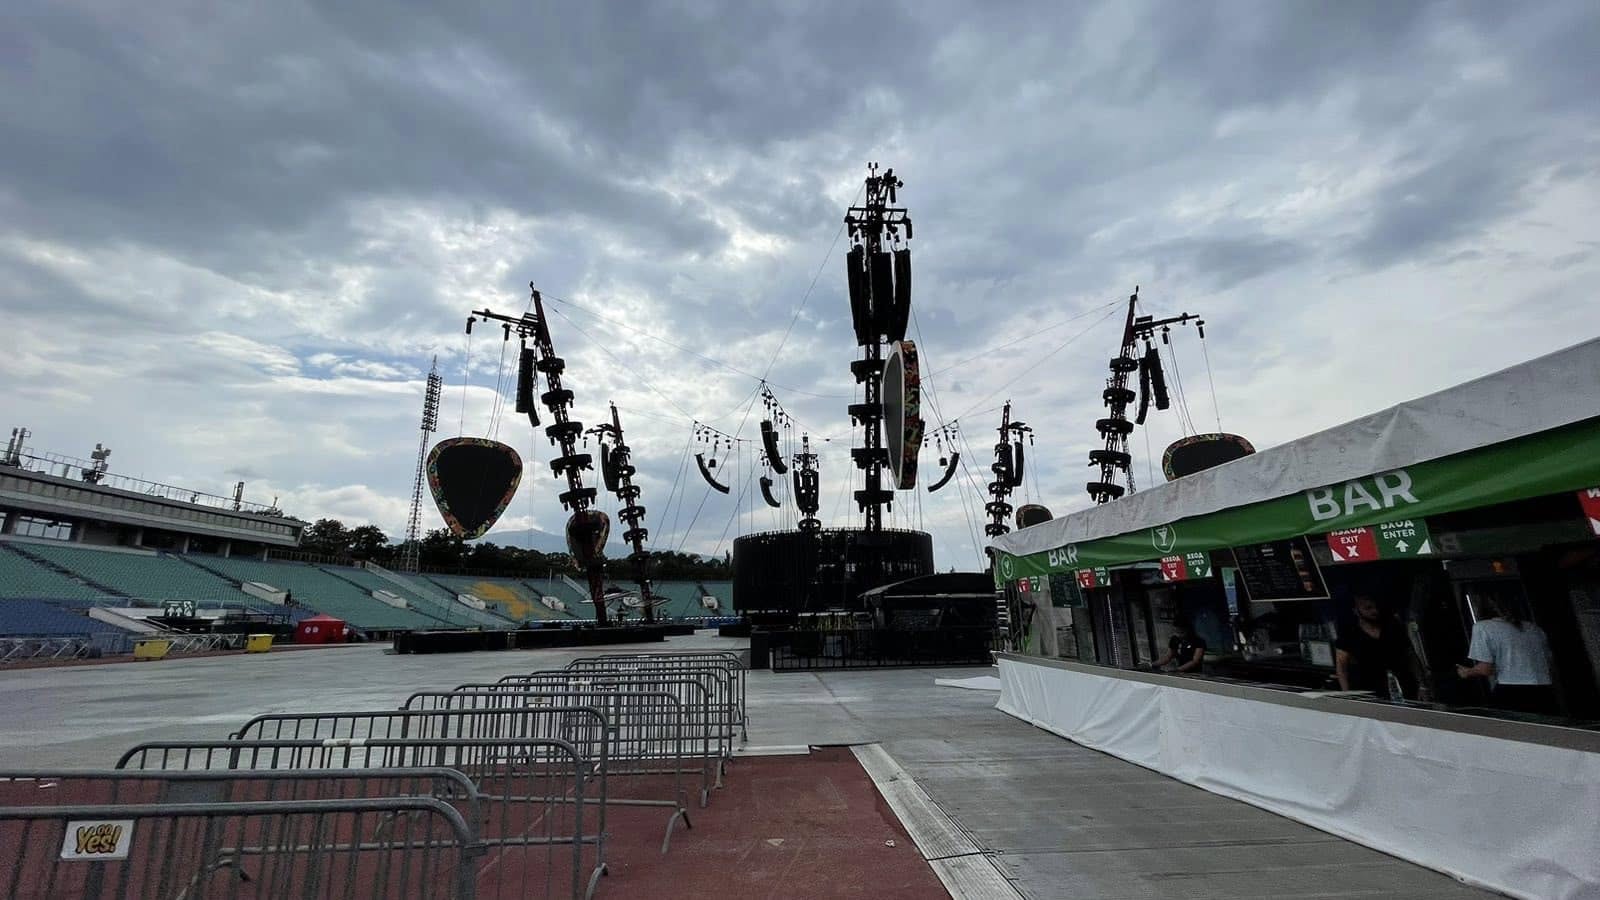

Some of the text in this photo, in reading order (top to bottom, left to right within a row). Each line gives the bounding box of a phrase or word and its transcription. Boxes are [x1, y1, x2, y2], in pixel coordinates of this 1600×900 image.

[1307, 470, 1419, 520] BAR
[1340, 535, 1359, 545] EXIT
[1383, 528, 1416, 539] ENTER
[1048, 544, 1079, 567] BAR
[75, 824, 122, 853] Yes!
